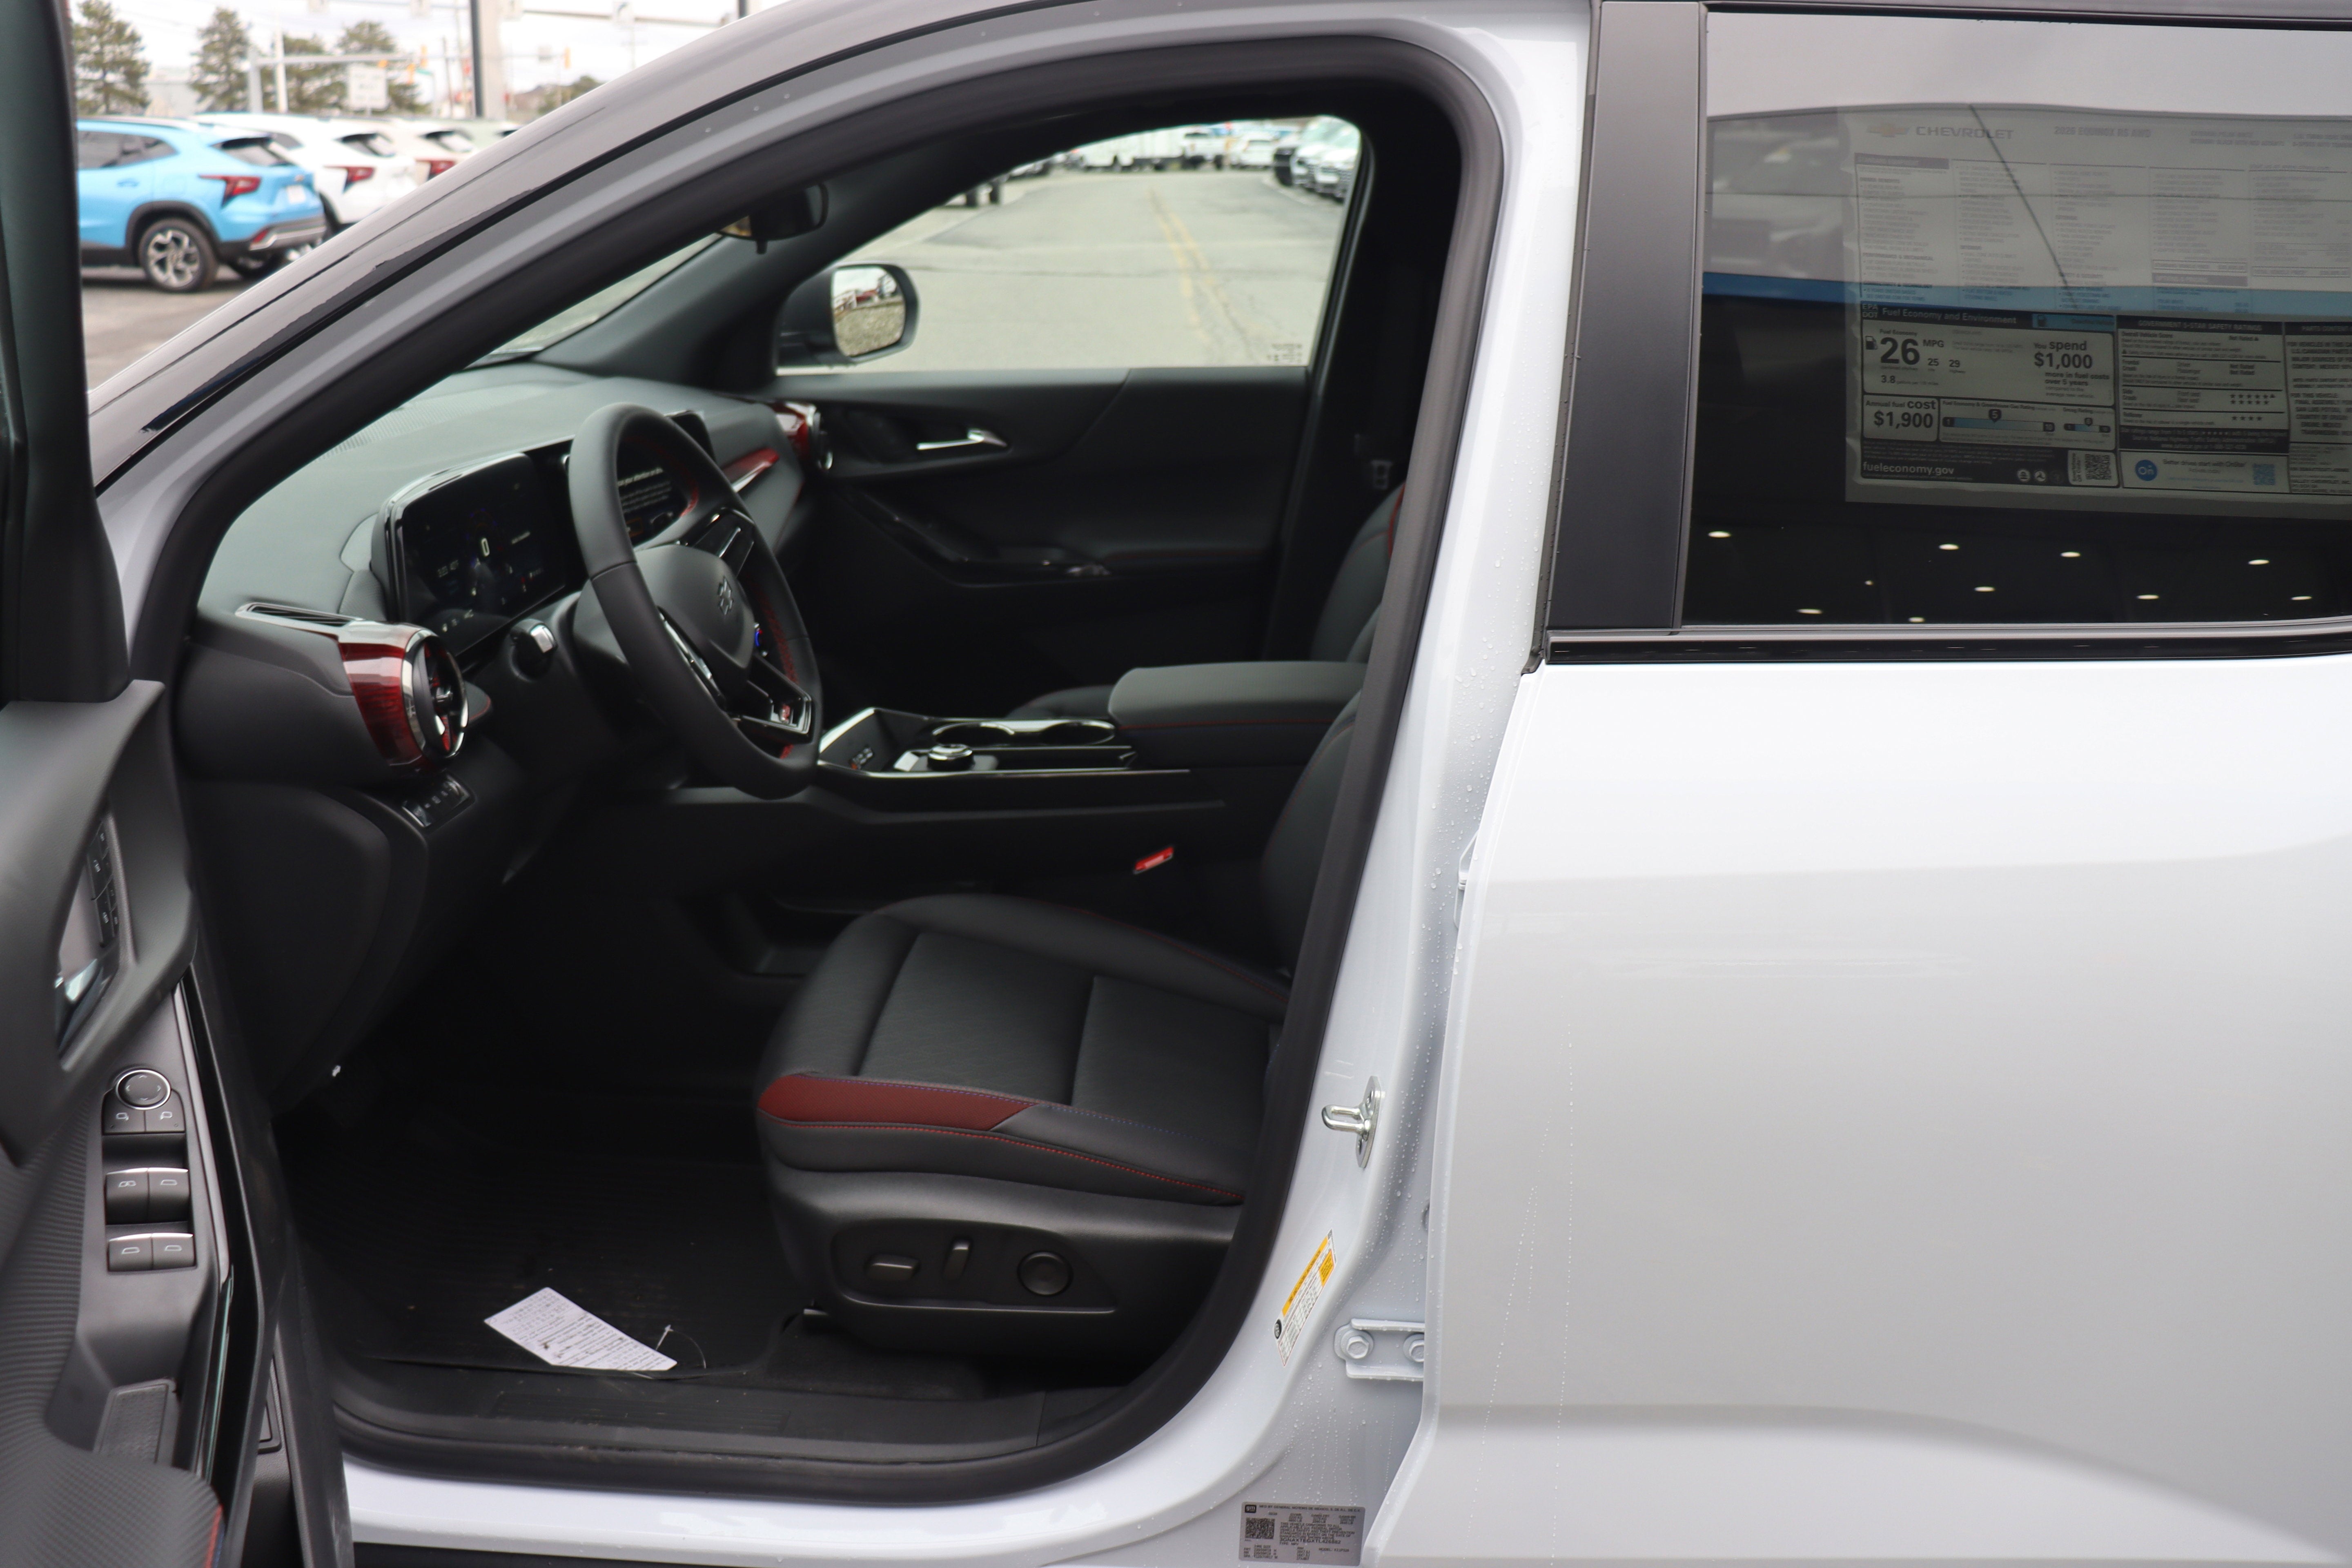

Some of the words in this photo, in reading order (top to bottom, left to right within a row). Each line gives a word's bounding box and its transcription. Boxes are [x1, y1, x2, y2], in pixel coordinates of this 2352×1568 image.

[1916, 126, 2014, 140] CHEVROLET
[1882, 307, 1901, 316] Fuel
[1902, 310, 1942, 321] Economy
[1944, 312, 1960, 321] and
[1962, 314, 2017, 324] Environment
[1923, 339, 1944, 347] MPG
[2049, 341, 2087, 352] spend
[1880, 337, 1920, 365] 26
[1949, 359, 1960, 368] 29
[2034, 351, 2092, 370] $1,000
[1881, 375, 1895, 383] 3.8
[1865, 400, 1891, 408] Annual
[1892, 400, 1906, 409] fuel
[1907, 399, 1936, 410] cost
[1873, 410, 1933, 430] $1,900
[1993, 410, 1998, 419] 5
[1863, 463, 1954, 476] fueleconomy.gov
[481, 537, 490, 557] 0
